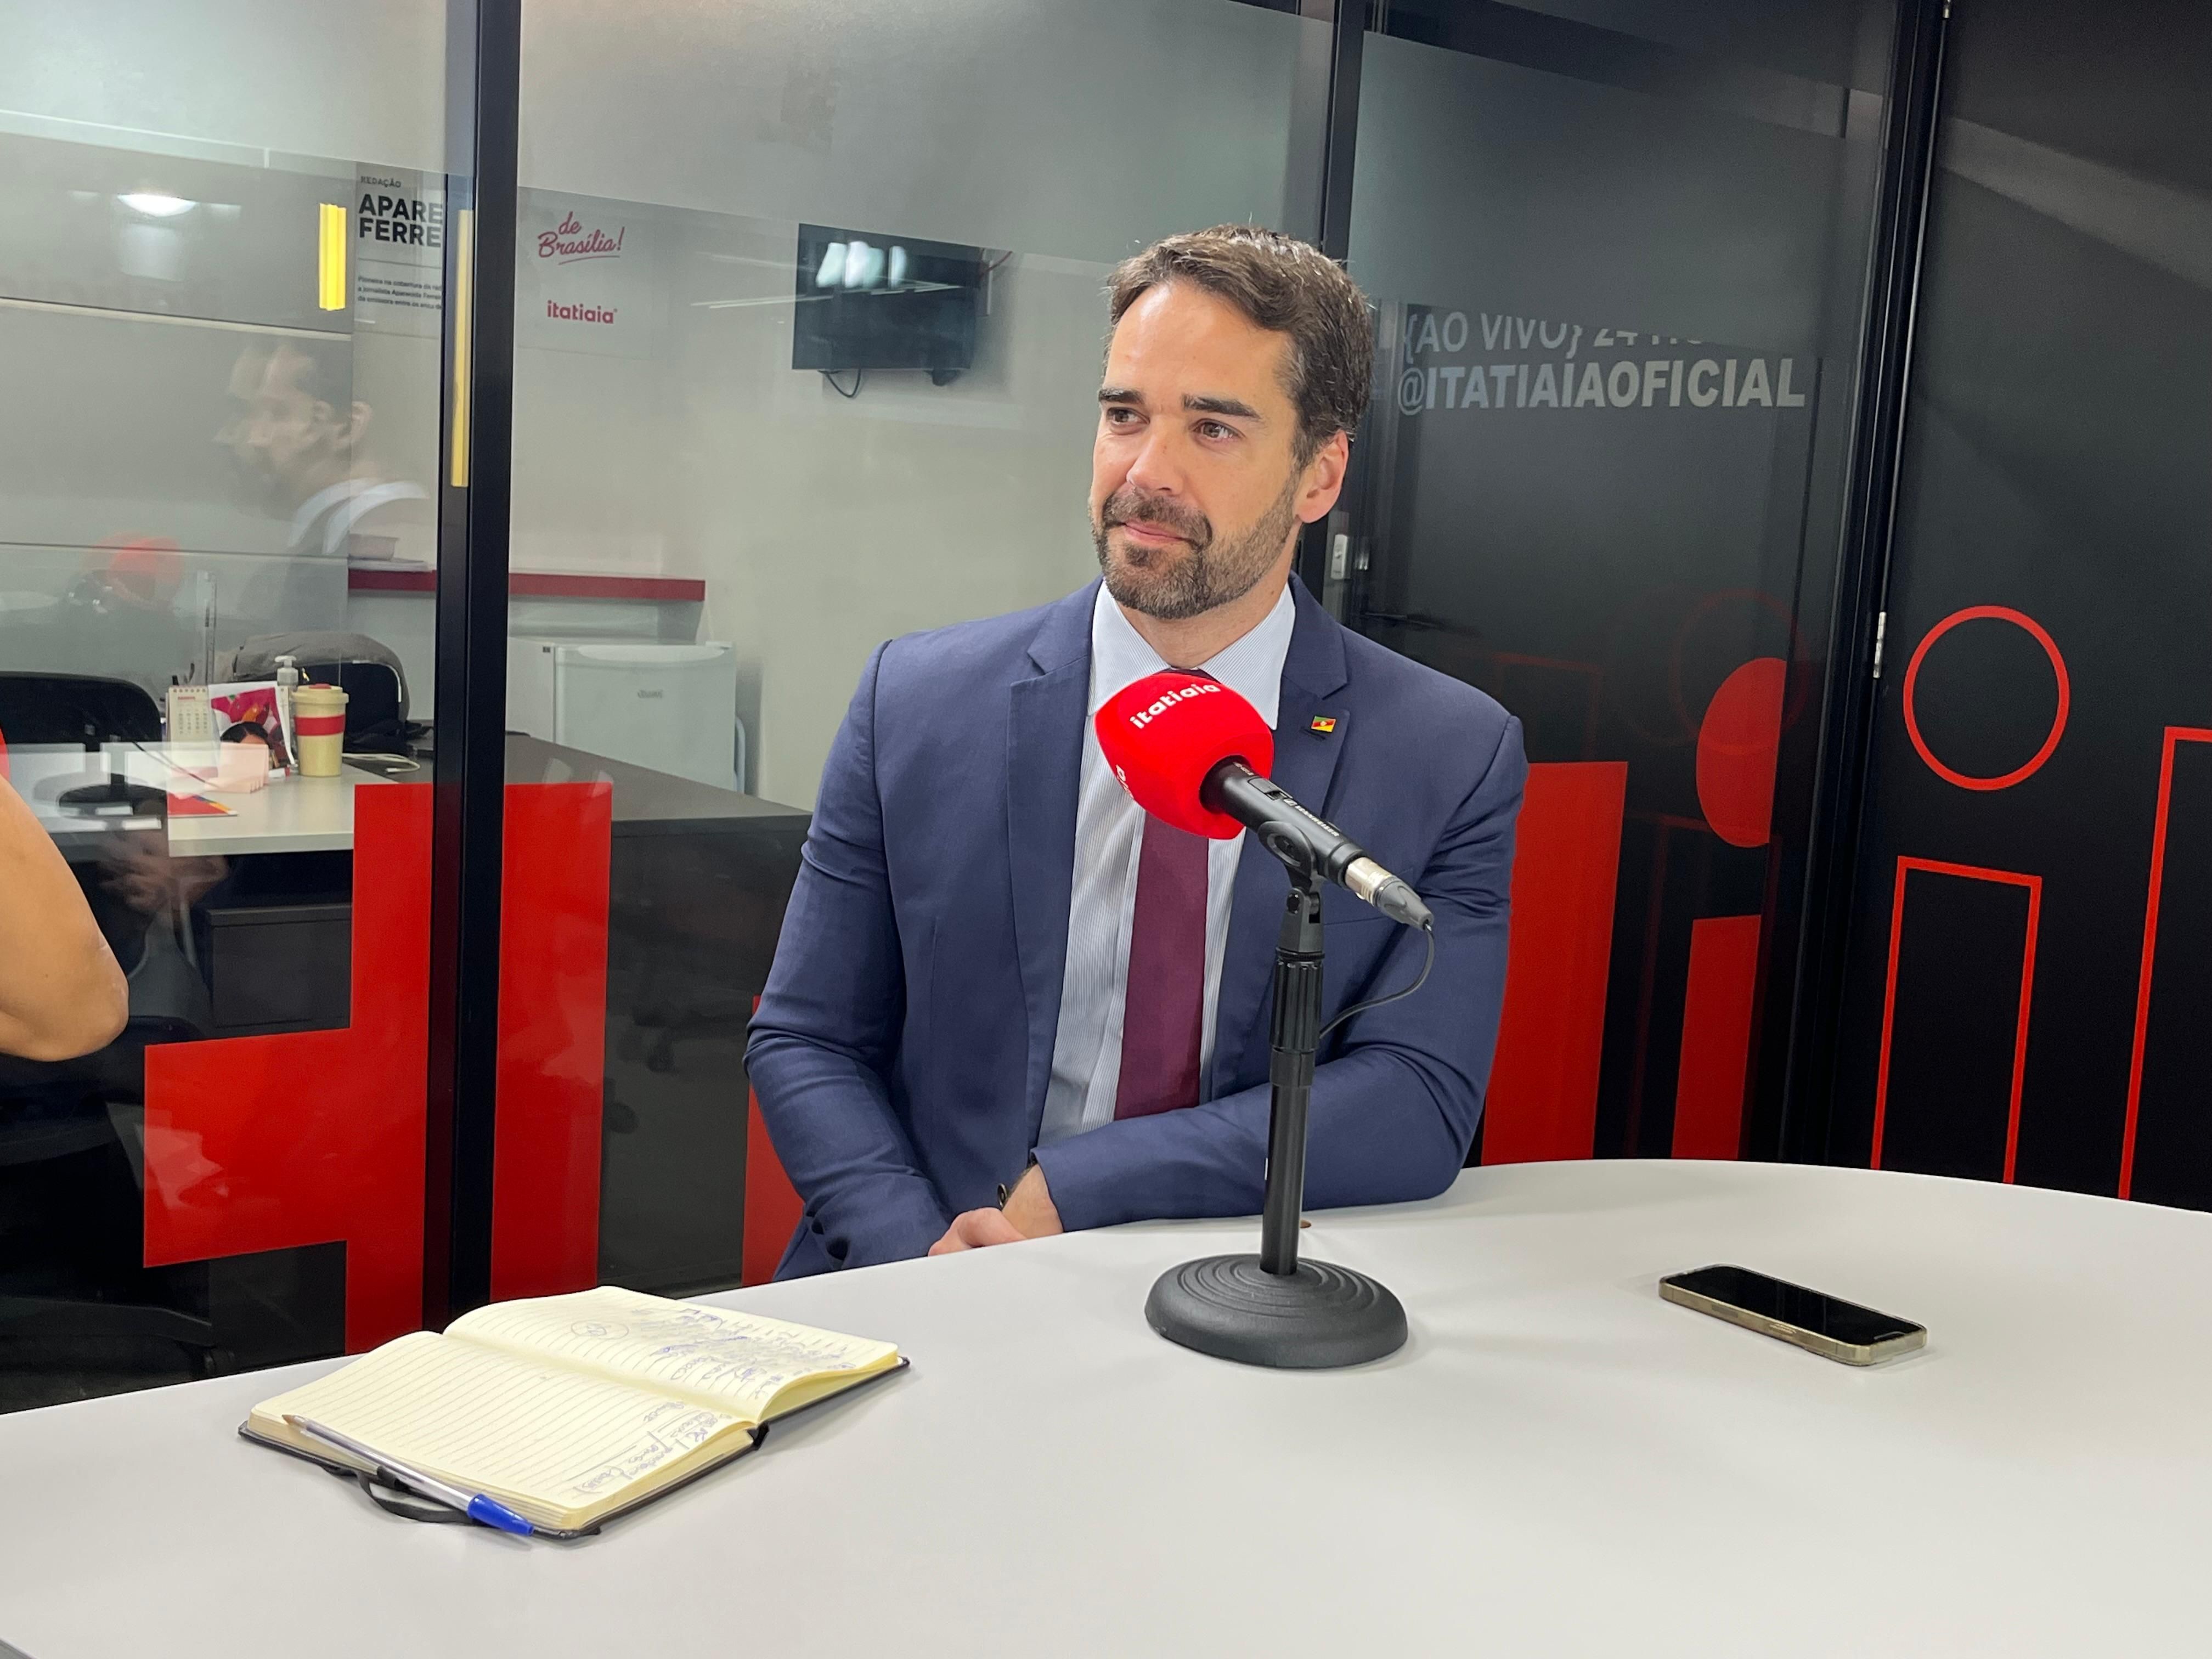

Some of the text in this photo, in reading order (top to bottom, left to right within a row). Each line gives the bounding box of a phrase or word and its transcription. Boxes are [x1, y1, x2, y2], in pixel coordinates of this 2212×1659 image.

[360, 176, 402, 188] REDAÇÃO
[358, 193, 443, 225] APARE
[558, 211, 582, 235] de
[359, 217, 442, 248] FERRE
[538, 227, 625, 258] Brasília!
[547, 300, 614, 324] itatiaia
[1398, 358, 1805, 416] @ITATIAIAOFICIAL
[1129, 684, 1221, 729] itatiaia
